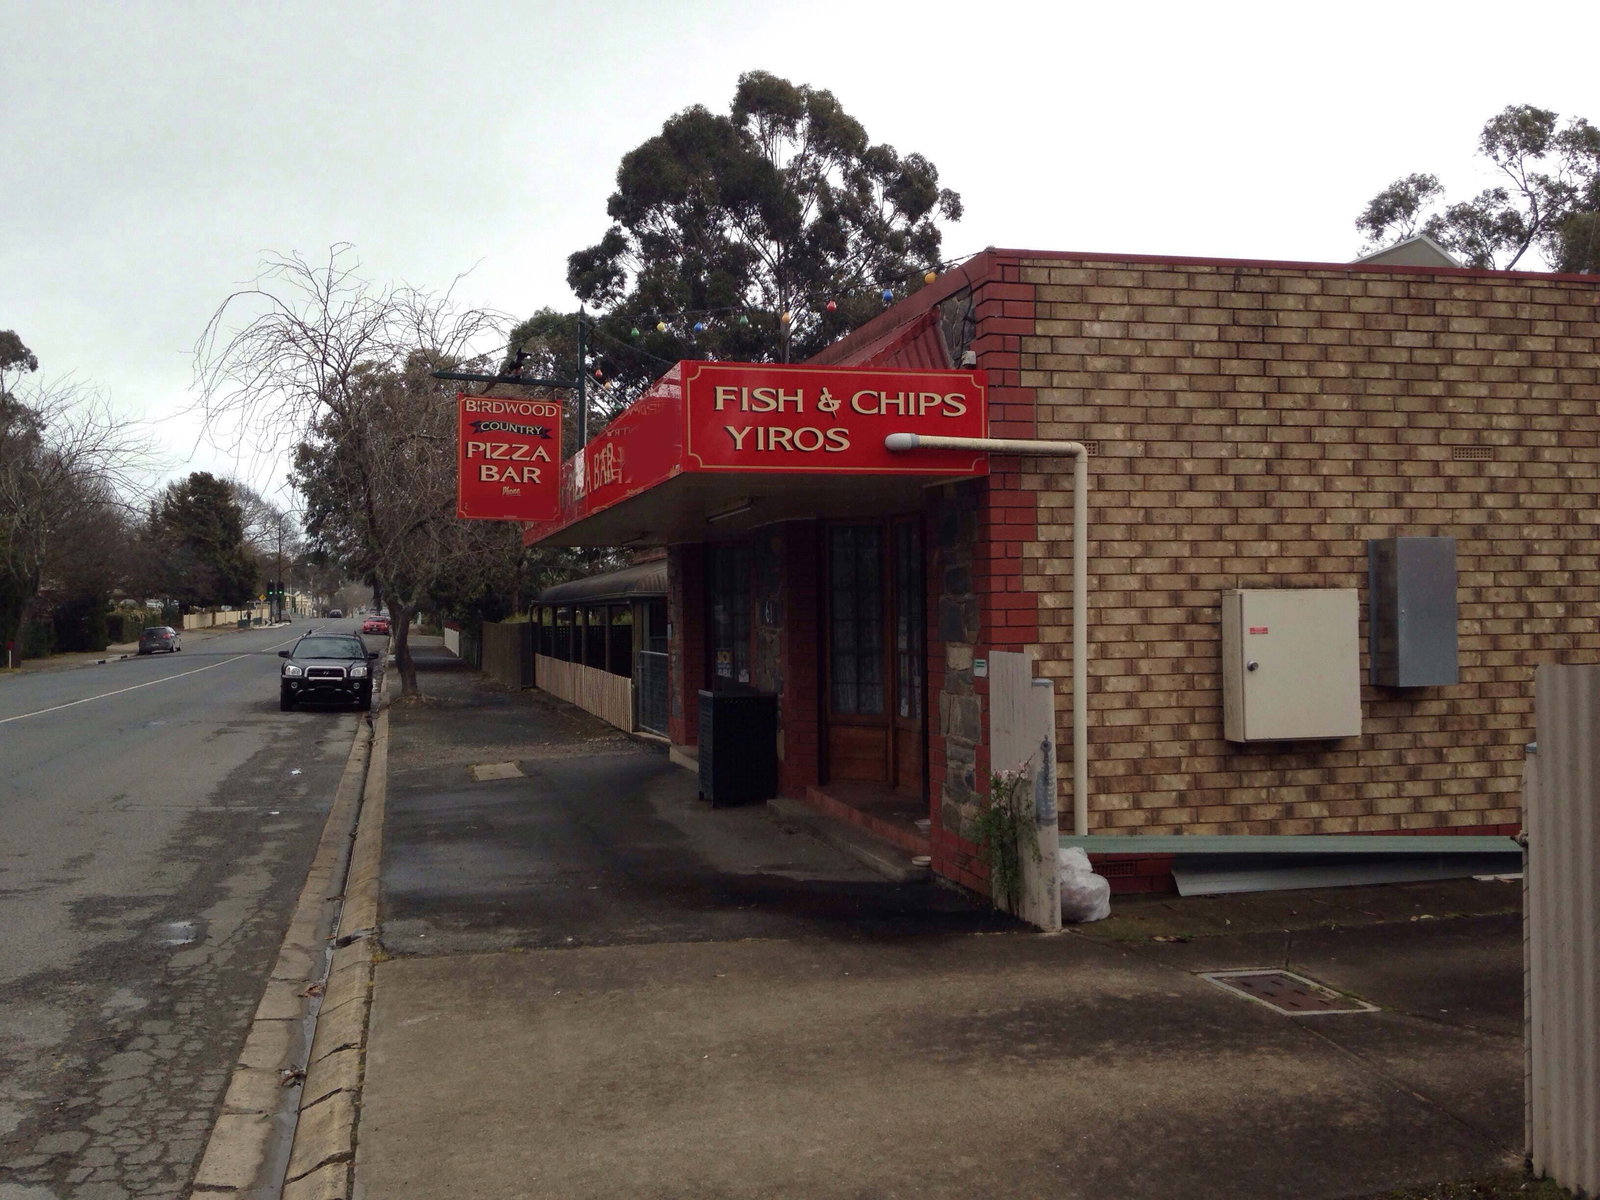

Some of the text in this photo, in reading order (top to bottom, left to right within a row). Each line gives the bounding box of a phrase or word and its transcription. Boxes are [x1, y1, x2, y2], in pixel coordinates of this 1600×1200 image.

[466, 400, 557, 417] BIRDWOOD
[714, 386, 967, 419] FISH & CHIPS
[480, 421, 542, 435] COUNTRY
[724, 426, 851, 452] YIROS
[466, 441, 551, 462] PIZZA
[480, 464, 542, 484] BAR
